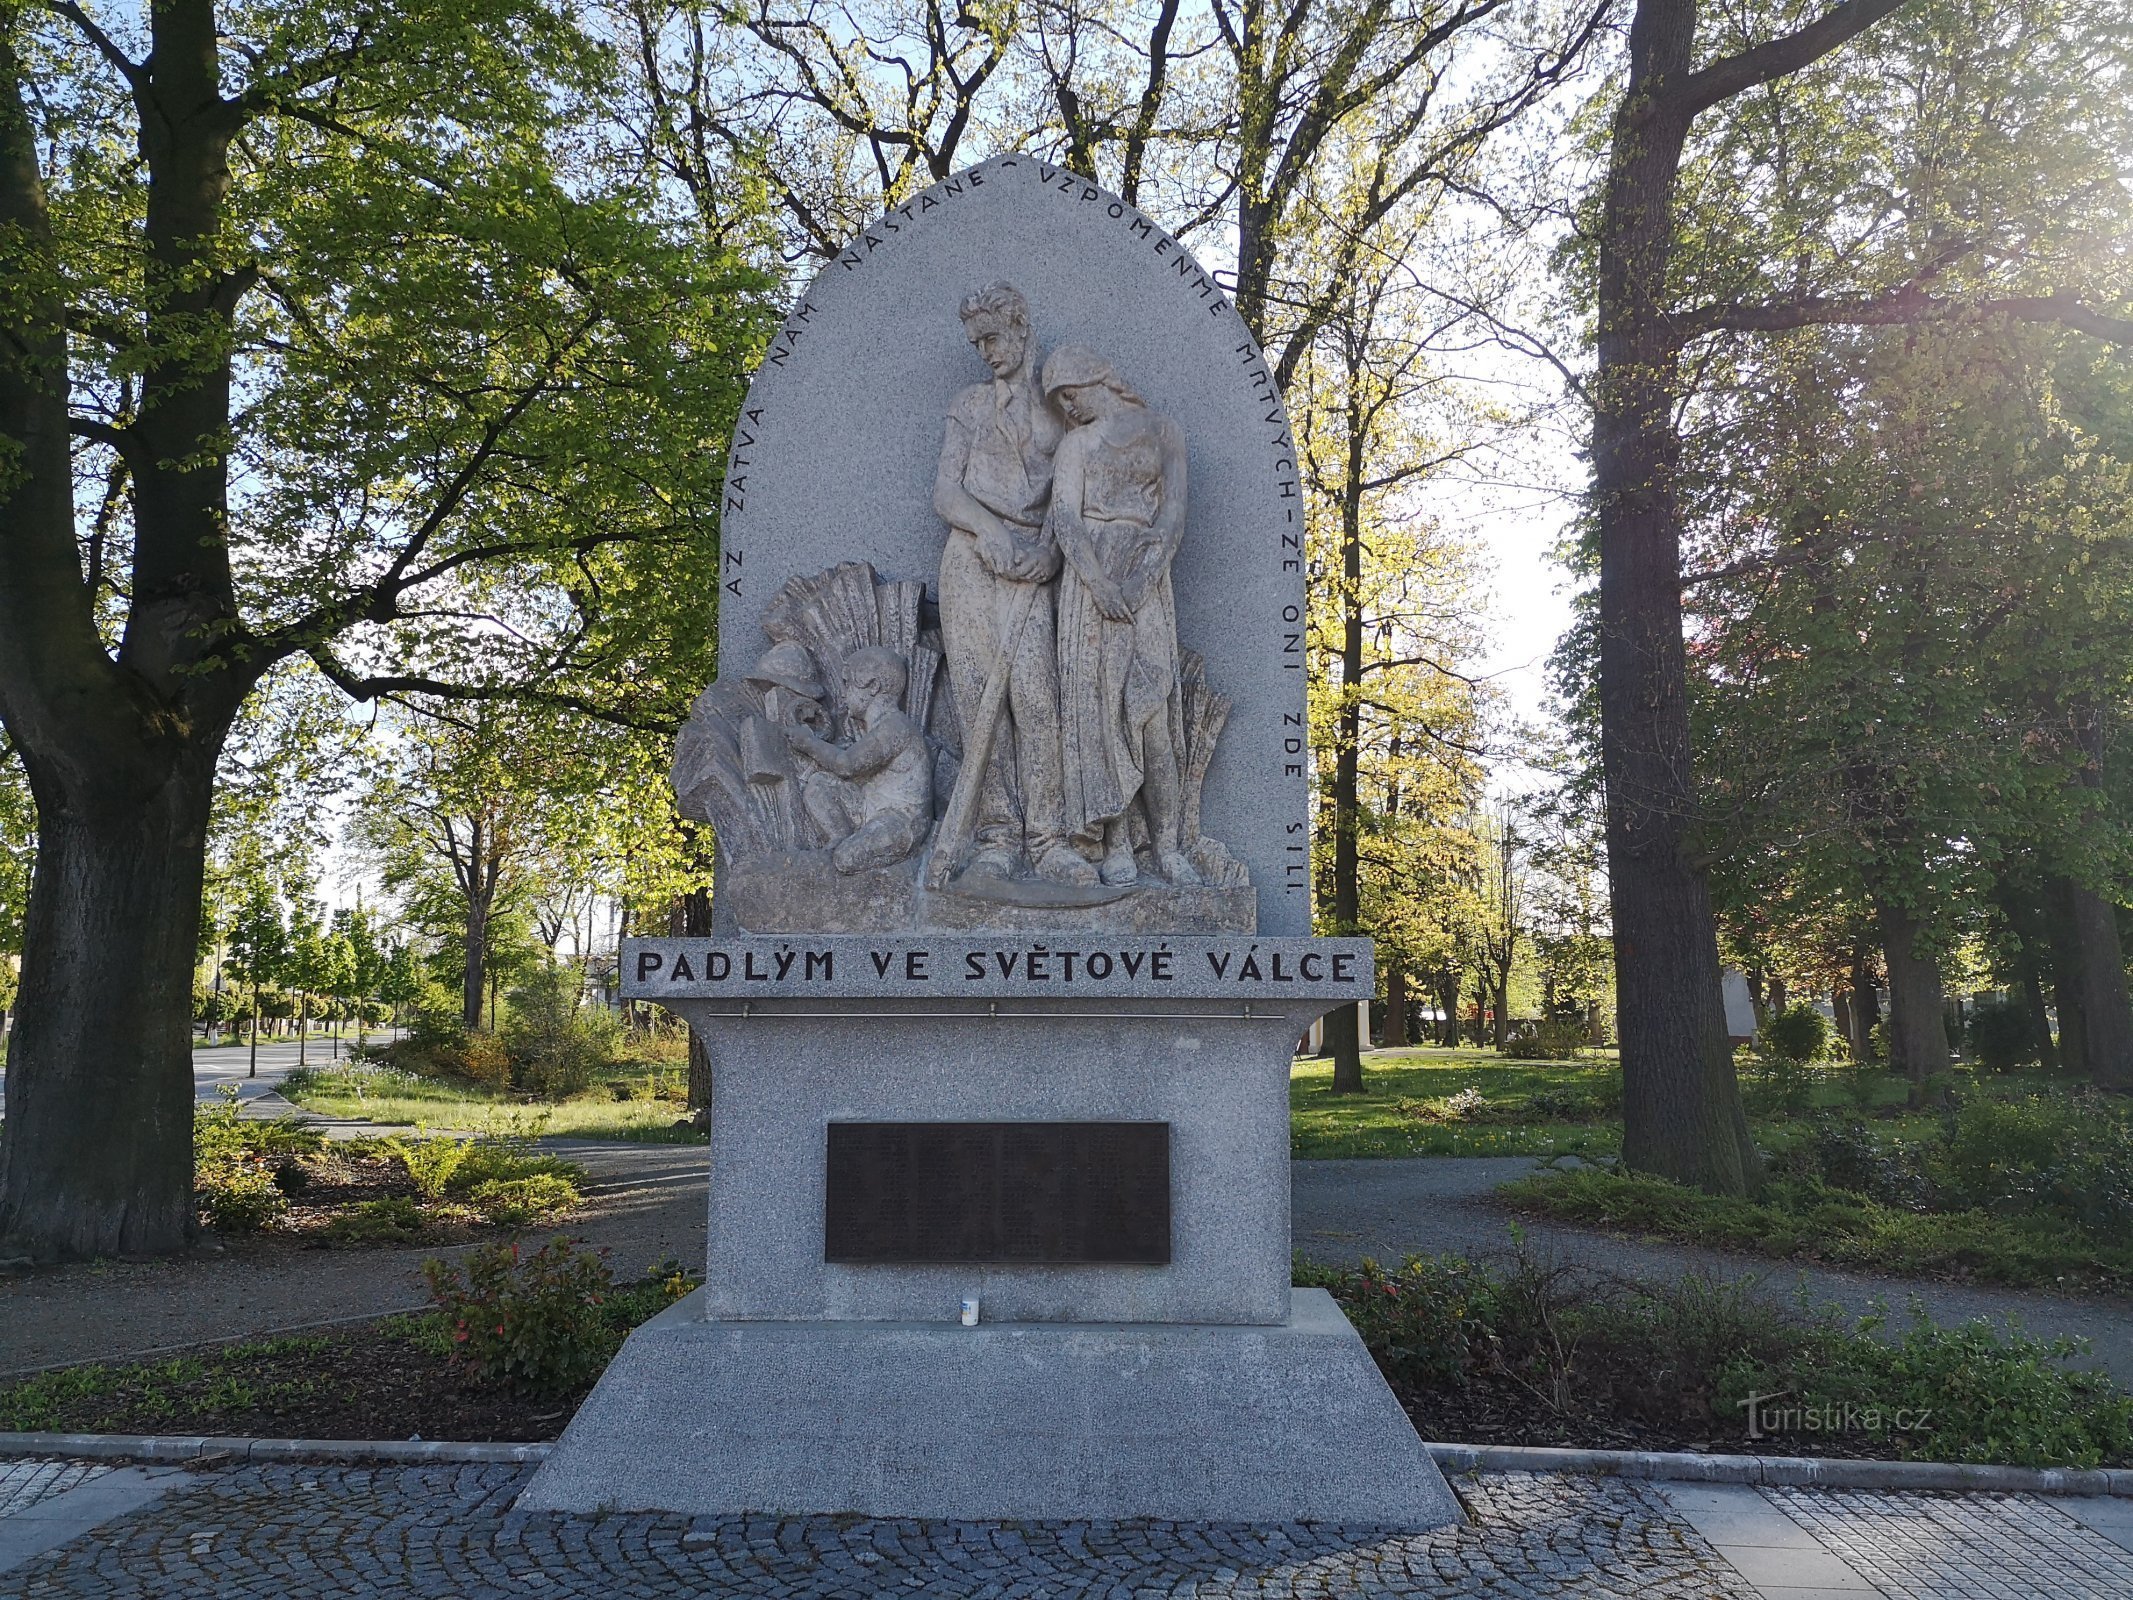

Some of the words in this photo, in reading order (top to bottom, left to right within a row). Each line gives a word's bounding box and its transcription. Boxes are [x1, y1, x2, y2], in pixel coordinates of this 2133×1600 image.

[842, 170, 983, 271] NASTANE
[1039, 167, 1228, 317] VZPOMEŇME
[771, 303, 818, 366] NÁM
[724, 408, 764, 517] ŽATVA
[725, 550, 743, 597] AŽ
[1282, 604, 1300, 669] ONI
[1283, 713, 1302, 777] ZDE
[1286, 822, 1304, 895] SILI.
[636, 944, 833, 982] PADLÝM
[871, 951, 929, 981] VE
[965, 943, 1173, 982] SVĚTOVÉ
[1206, 944, 1356, 983] VÁLCE
